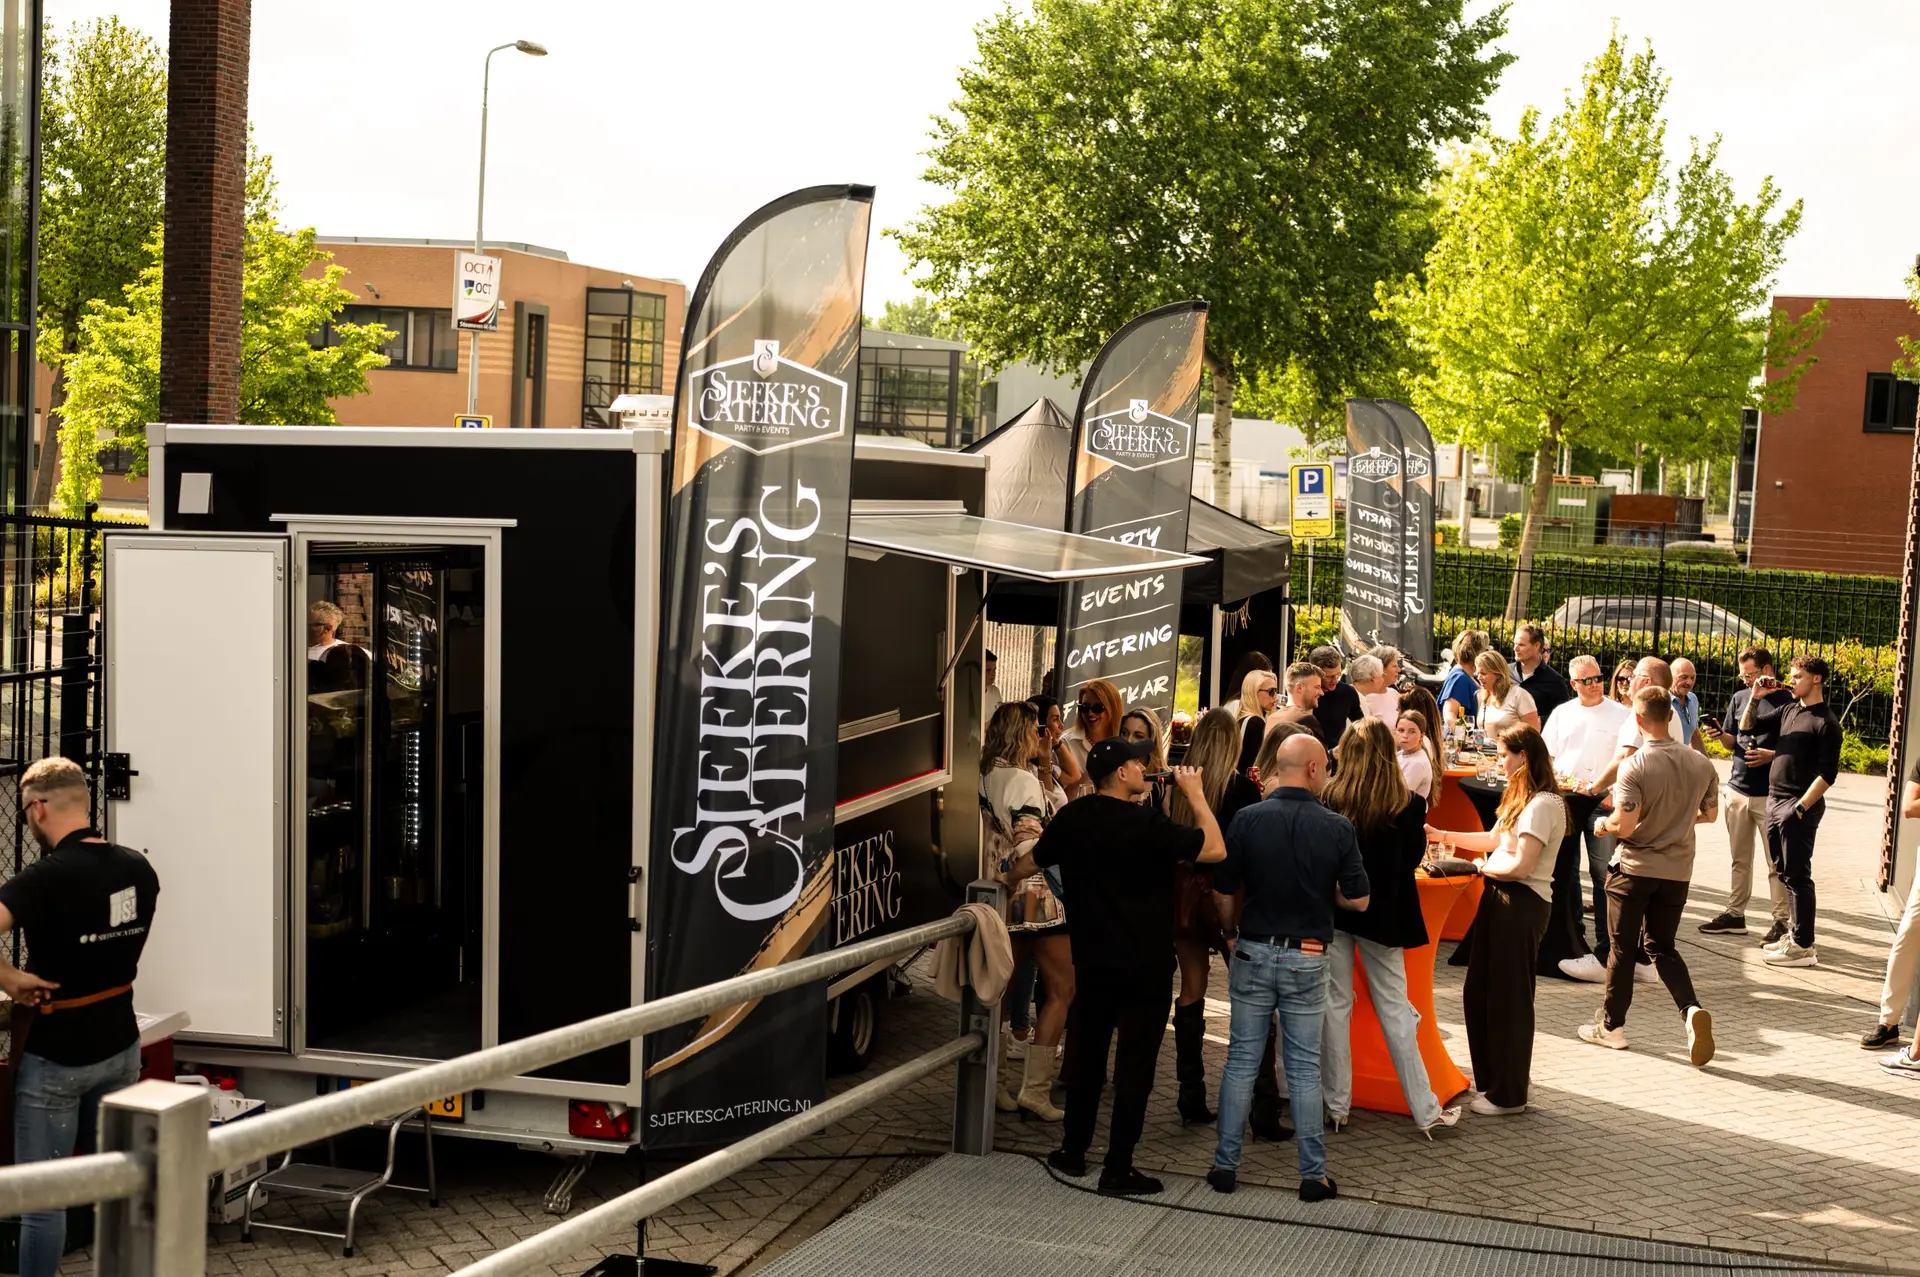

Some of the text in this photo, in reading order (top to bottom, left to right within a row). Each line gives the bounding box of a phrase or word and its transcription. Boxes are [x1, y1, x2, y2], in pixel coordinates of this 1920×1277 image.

[475, 282, 492, 295] OCT
[699, 387, 832, 430] CATERING
[709, 370, 822, 409] SJEFKE'S
[734, 424, 756, 433] PARTY
[761, 426, 790, 435] EVENTS
[1092, 428, 1181, 455] CATERING
[1100, 418, 1174, 442] SJEFKE'S
[1303, 470, 1320, 493] P
[1108, 525, 1162, 548] RTY
[1080, 573, 1165, 612] EVENTS
[1066, 623, 1173, 669] CATERING
[670, 517, 761, 876] SJEFKE'S
[714, 478, 821, 922] CATERING
[1063, 675, 1169, 721] FTKAR
[832, 829, 894, 901] FKE'S
[831, 871, 902, 947] ERING
